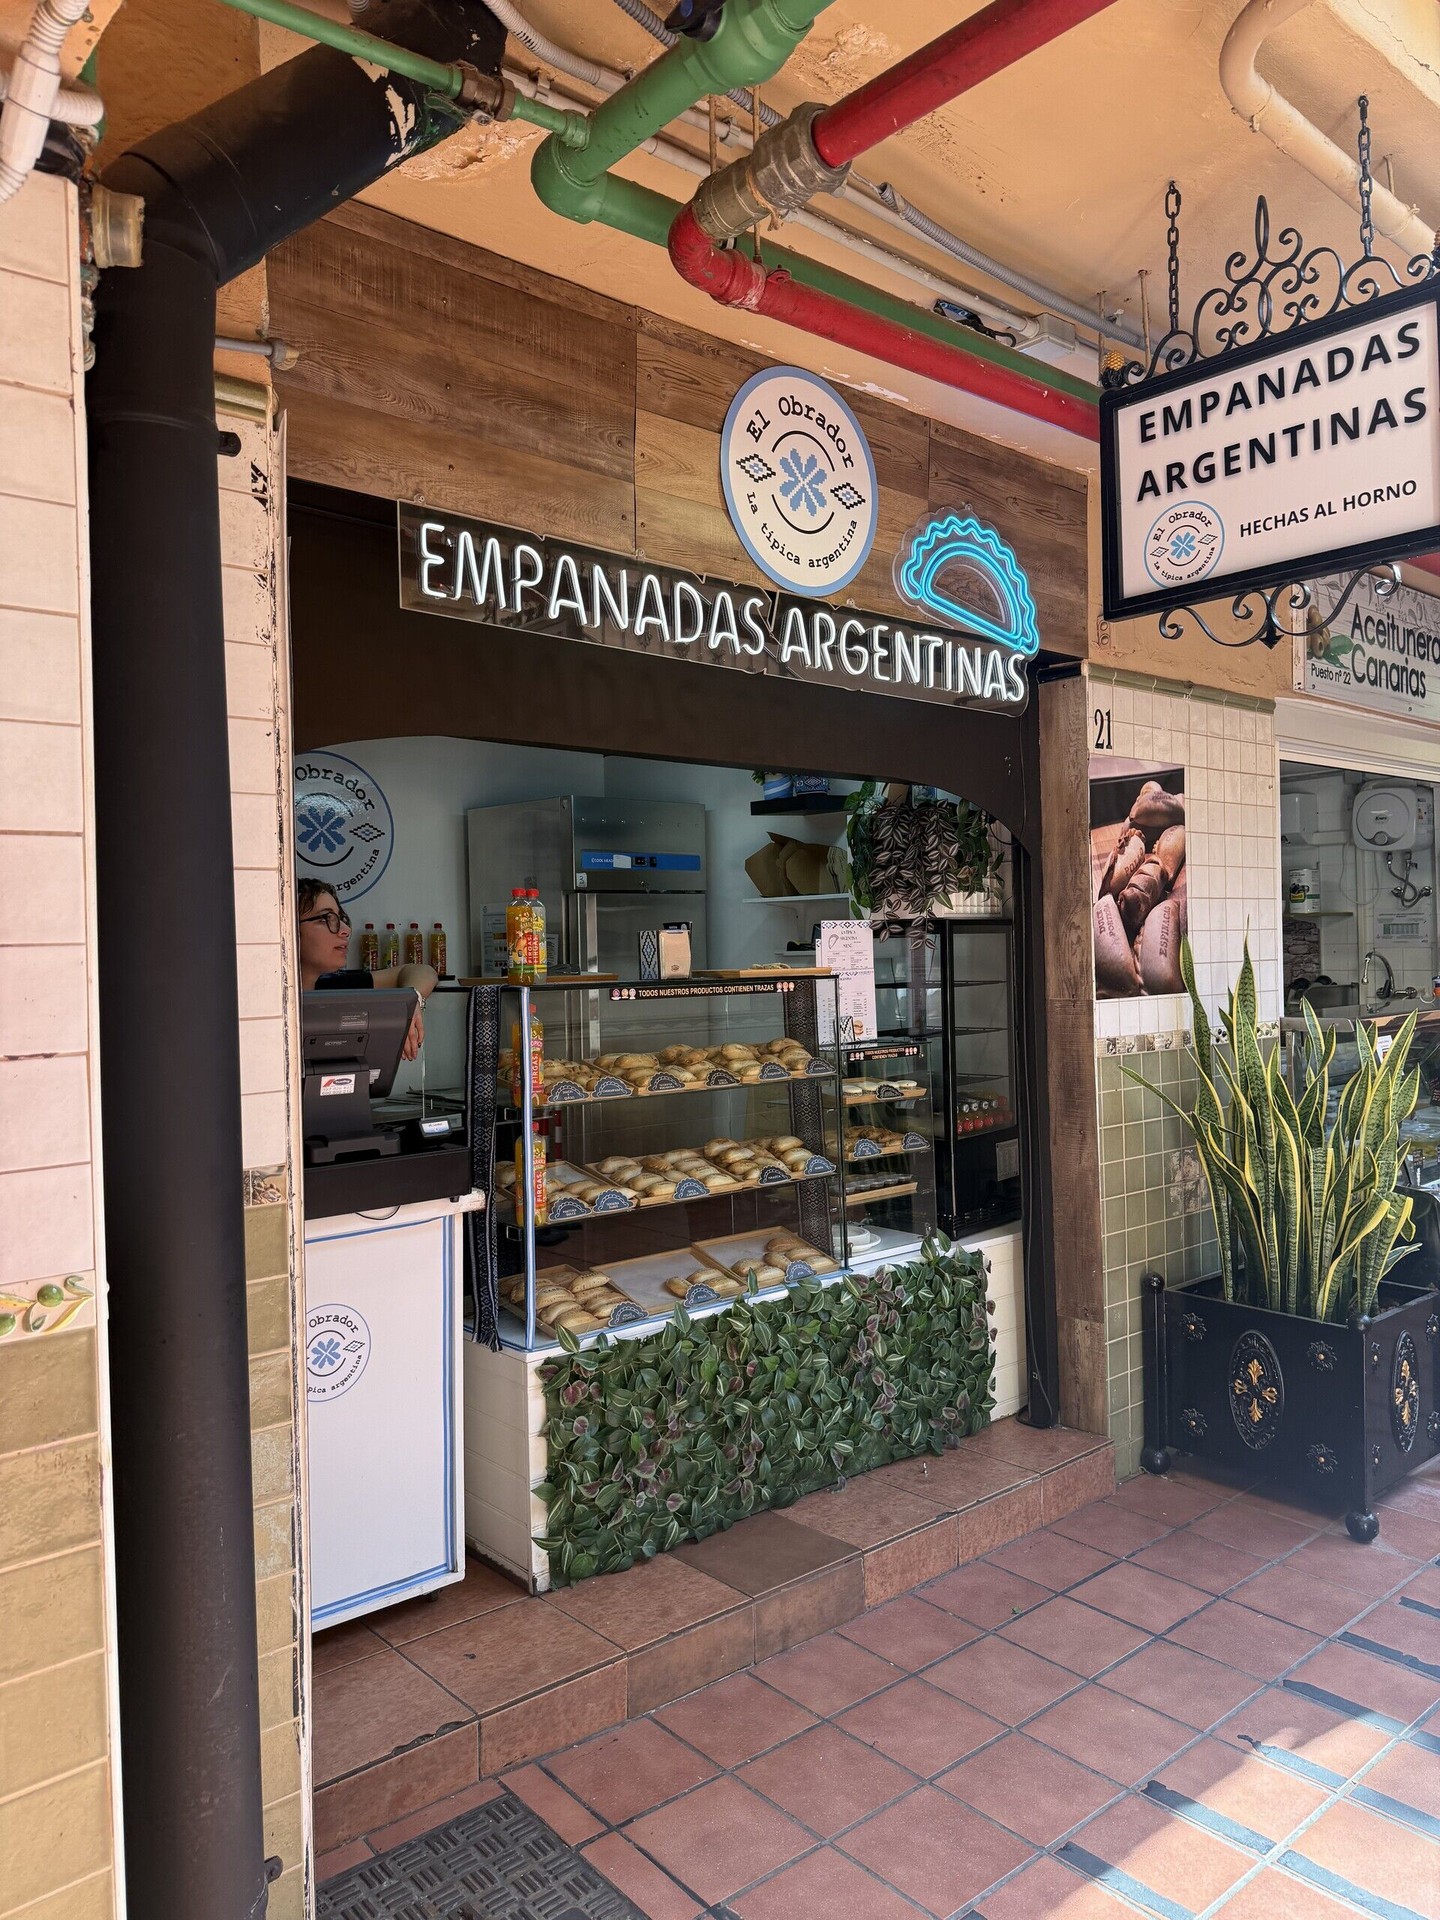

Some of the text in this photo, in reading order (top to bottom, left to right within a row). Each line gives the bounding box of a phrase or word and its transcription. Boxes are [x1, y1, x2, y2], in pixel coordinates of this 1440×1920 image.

[1140, 321, 1421, 444] EMPANADAS
[746, 394, 855, 469] El Obrador
[1137, 386, 1427, 503] ARGENTINAS
[746, 491, 759, 515] La
[808, 519, 858, 570] argentina
[1152, 510, 1213, 542] El Obrador
[1239, 479, 1418, 538] HECHAS AL HORNO
[419, 521, 1026, 703] EMPANADAS ARGENTINAS
[1310, 662, 1334, 681] Puesto
[1342, 671, 1352, 686] 22
[1351, 643, 1427, 700] Canarias
[1093, 708, 1114, 750] 21
[294, 763, 375, 812] Obrador
[334, 847, 380, 892] rgentina
[1159, 904, 1171, 958] ESPINACAS
[638, 983, 774, 998] TODOS NUESTROS PRODUCTOS CONTIENEN TRAZAS
[308, 1314, 358, 1333] Obrador
[331, 1354, 362, 1391] argentina
